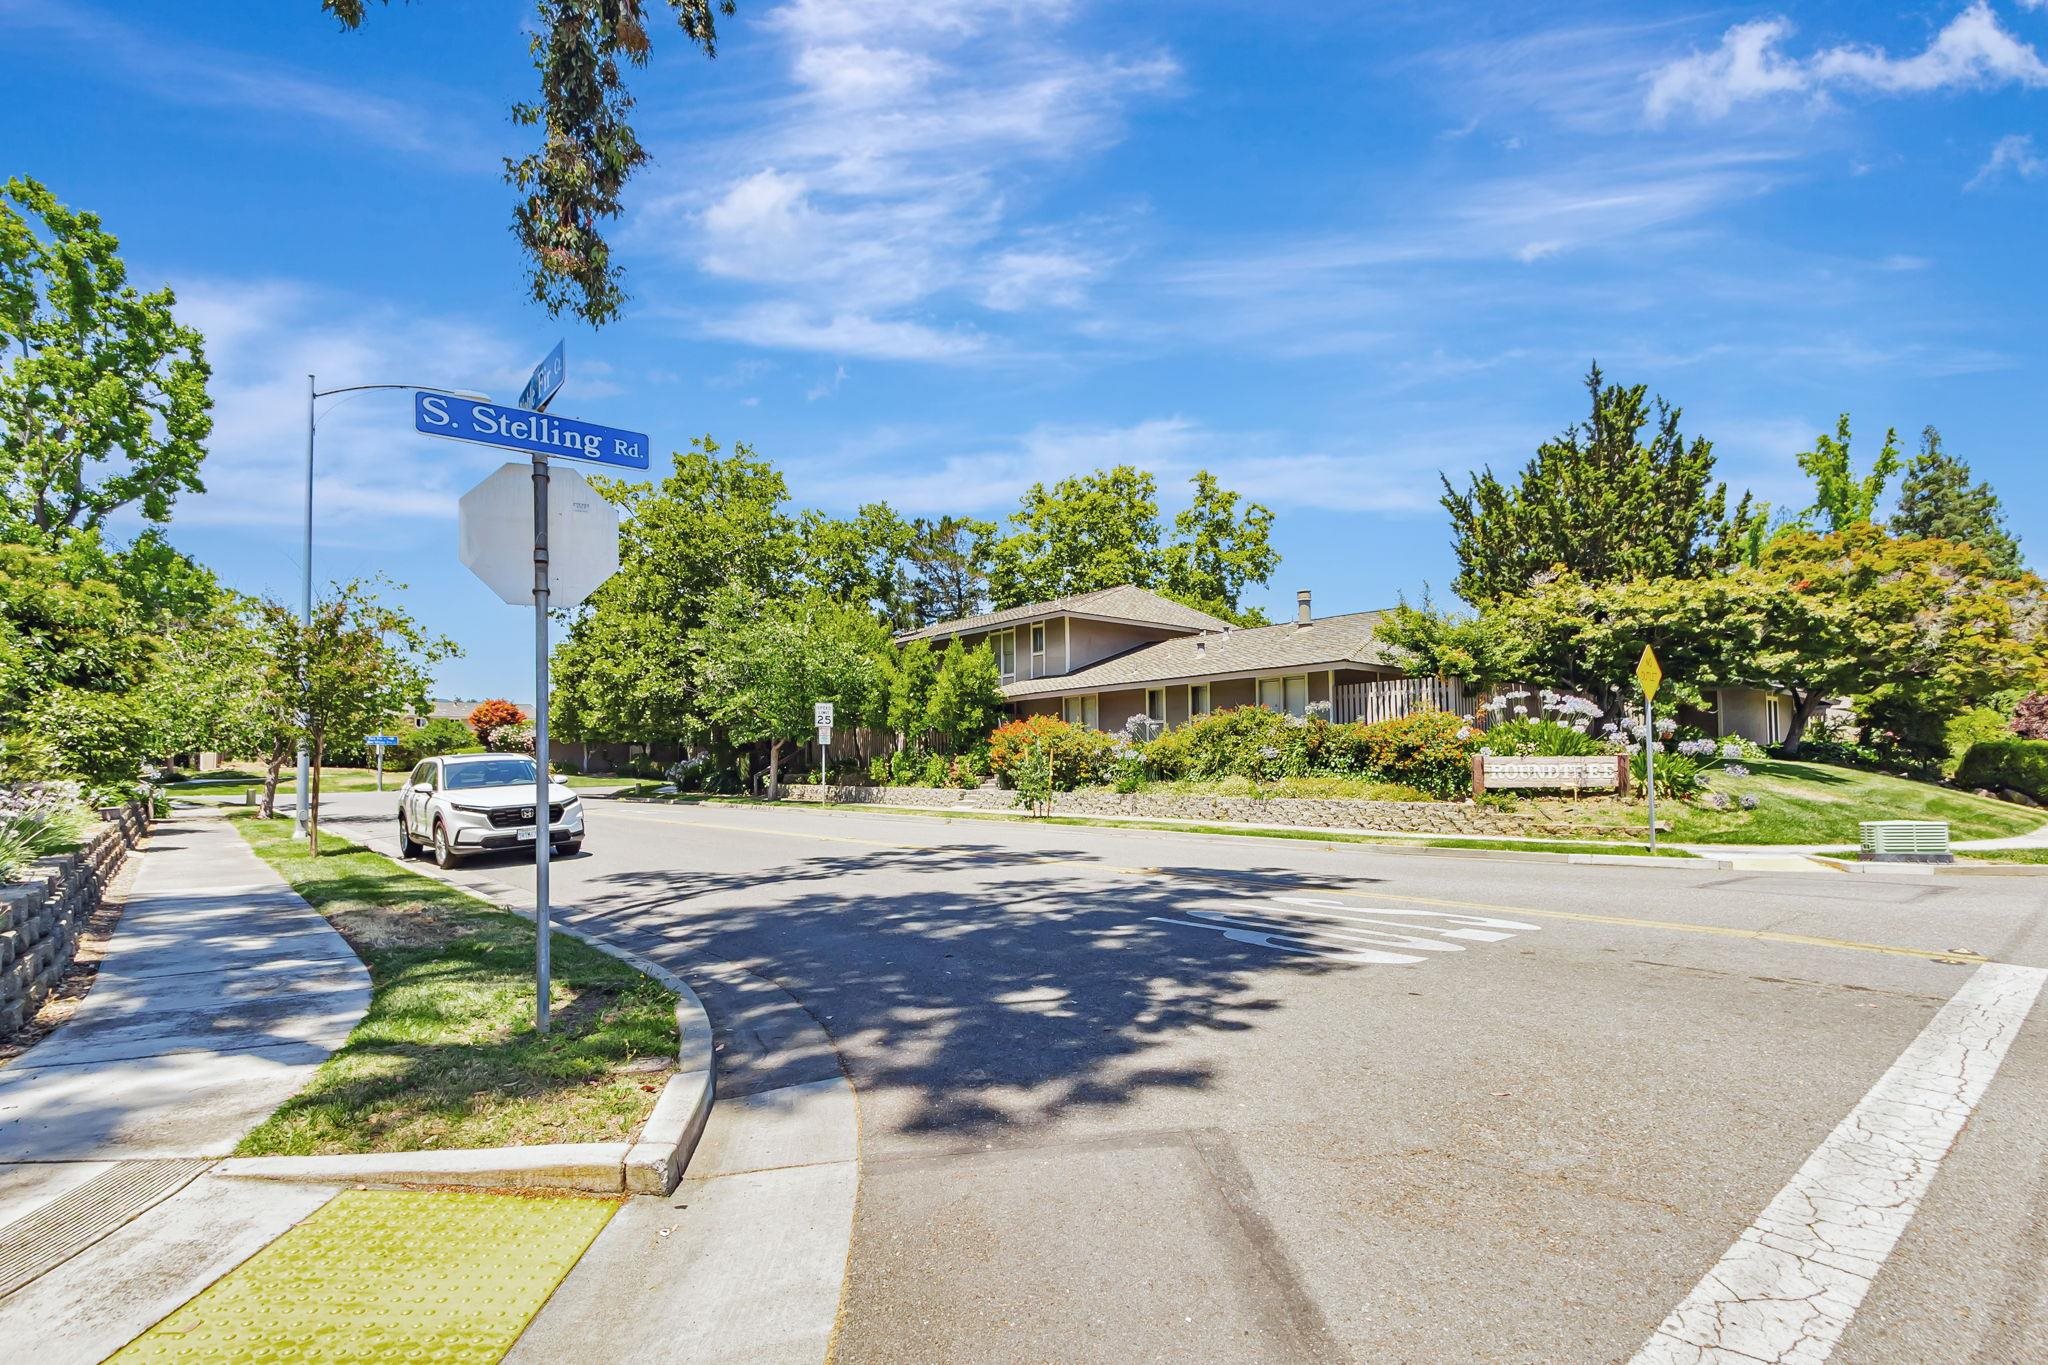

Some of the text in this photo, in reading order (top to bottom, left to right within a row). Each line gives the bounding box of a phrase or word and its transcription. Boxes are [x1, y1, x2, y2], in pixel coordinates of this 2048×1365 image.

[422, 396, 644, 459] S. Stelling Rd.
[818, 716, 831, 724] 25
[1491, 763, 1615, 781] ROUNDTREE
